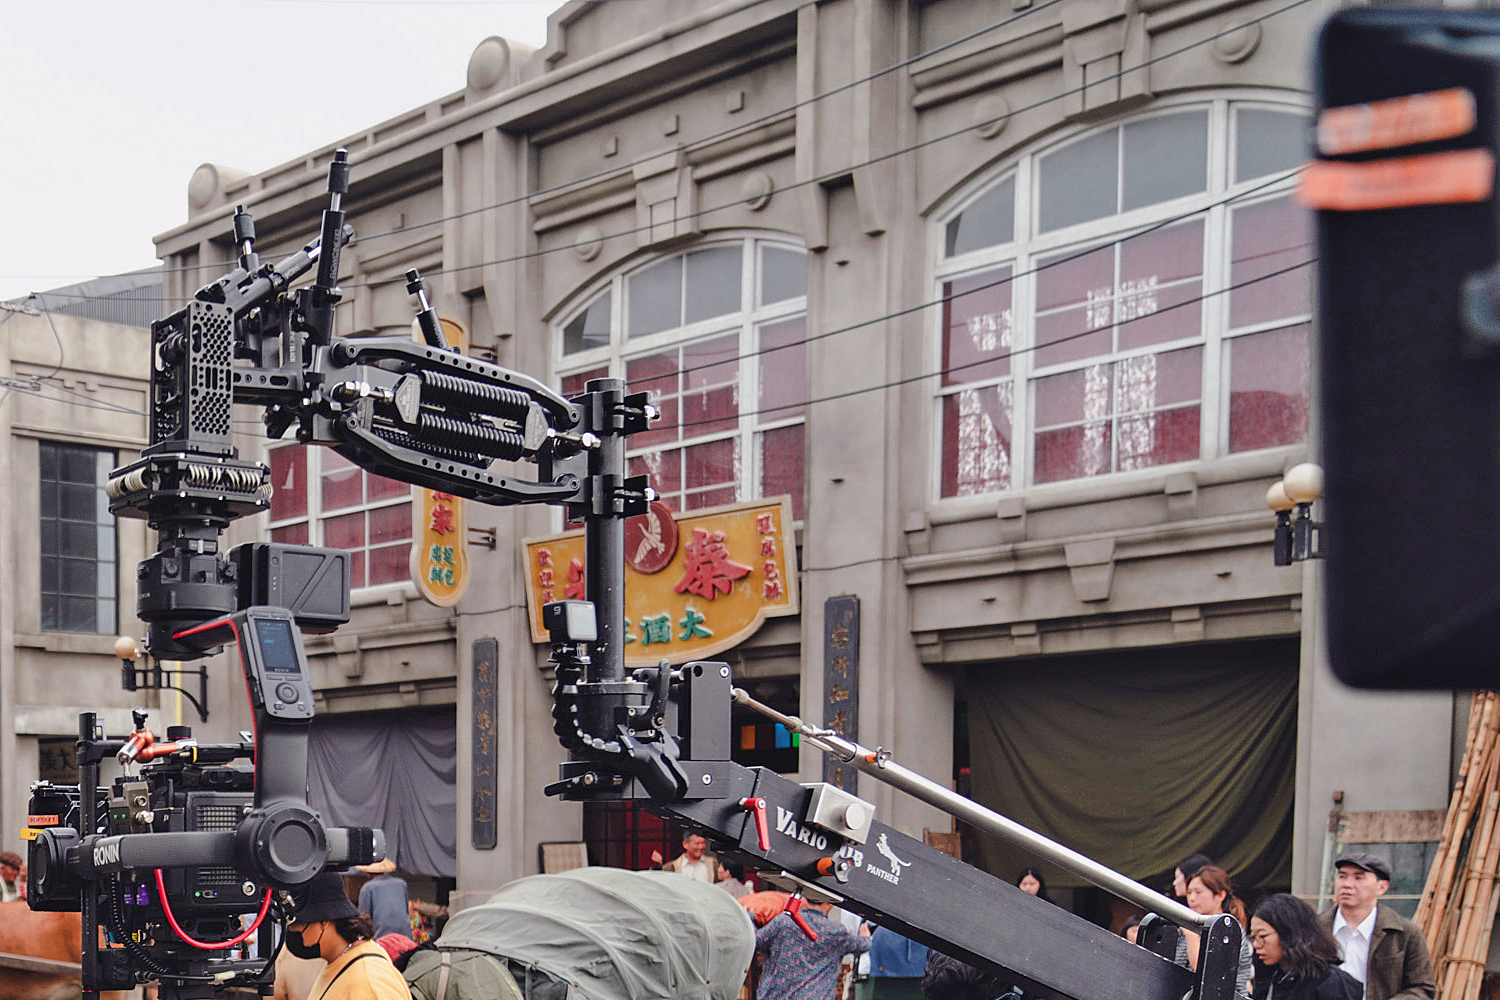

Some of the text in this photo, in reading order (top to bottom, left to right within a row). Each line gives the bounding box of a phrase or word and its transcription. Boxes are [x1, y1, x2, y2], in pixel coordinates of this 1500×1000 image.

[776, 806, 828, 850] VARIO
[93, 843, 120, 867] RONIN
[866, 863, 900, 885] PANTHER
